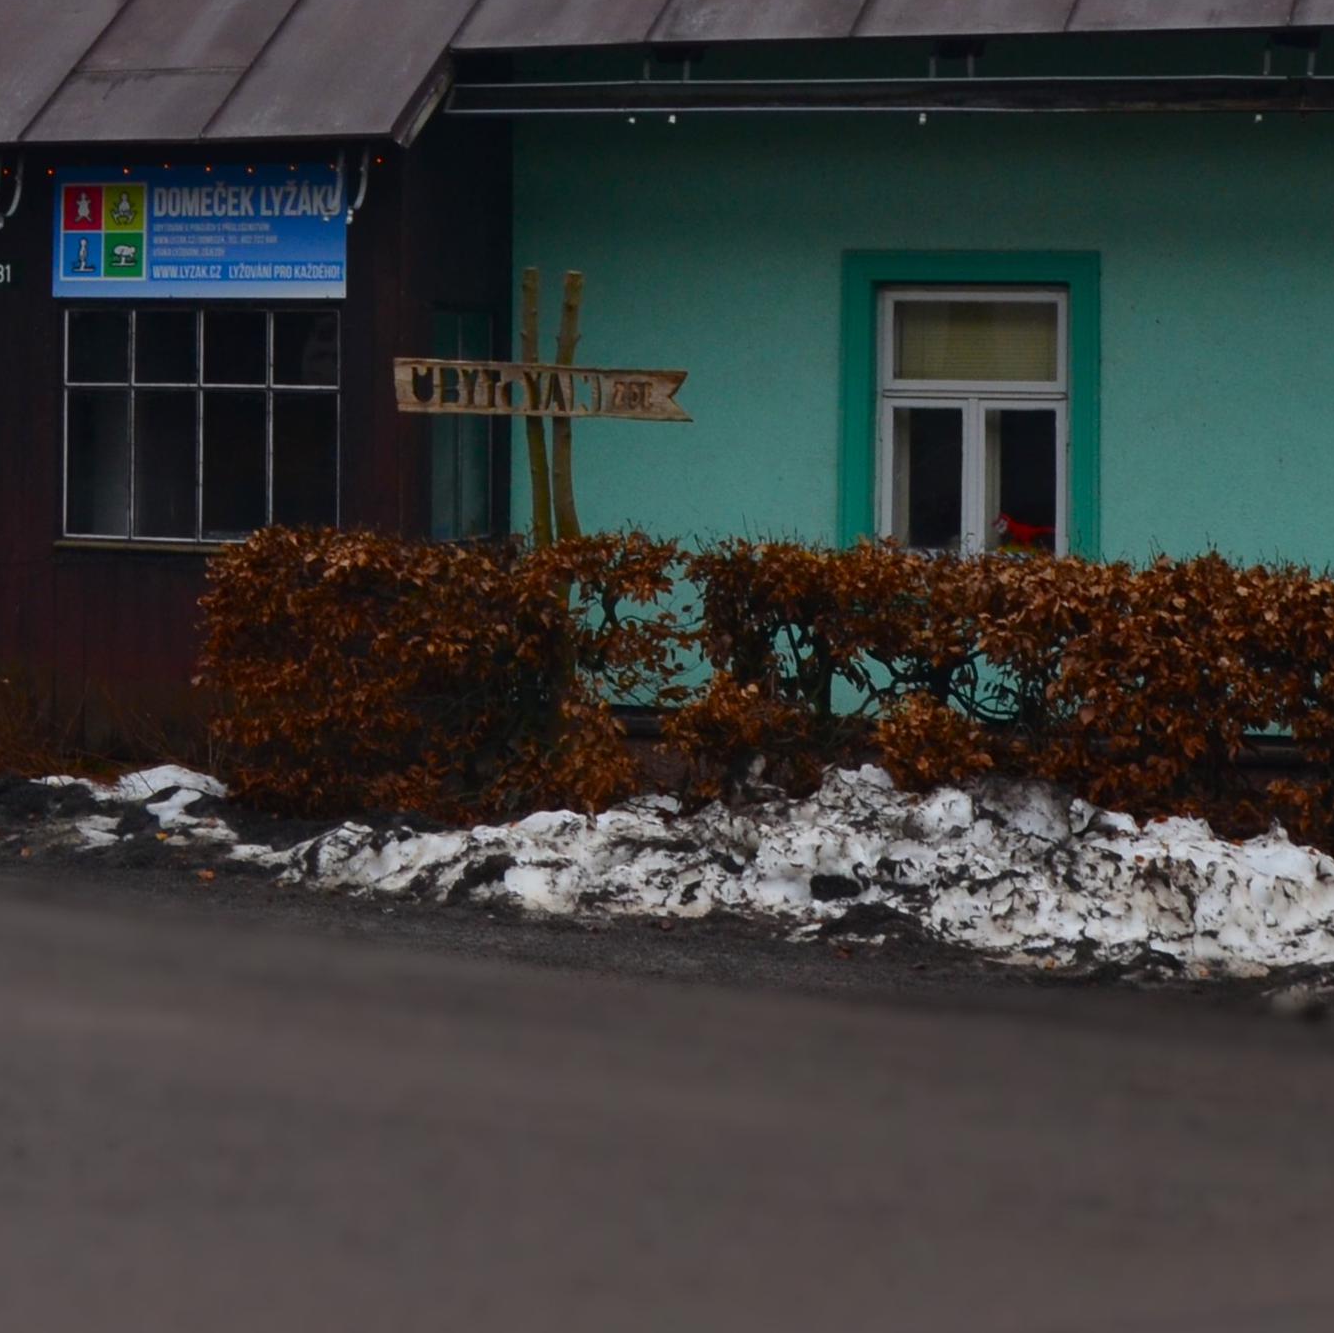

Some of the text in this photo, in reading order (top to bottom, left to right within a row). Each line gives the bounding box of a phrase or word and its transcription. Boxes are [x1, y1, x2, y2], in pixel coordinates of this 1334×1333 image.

[153, 180, 255, 217] DOMEČEK
[152, 264, 222, 279] WWW.LYZAK.CZ
[273, 264, 293, 279] PRO
